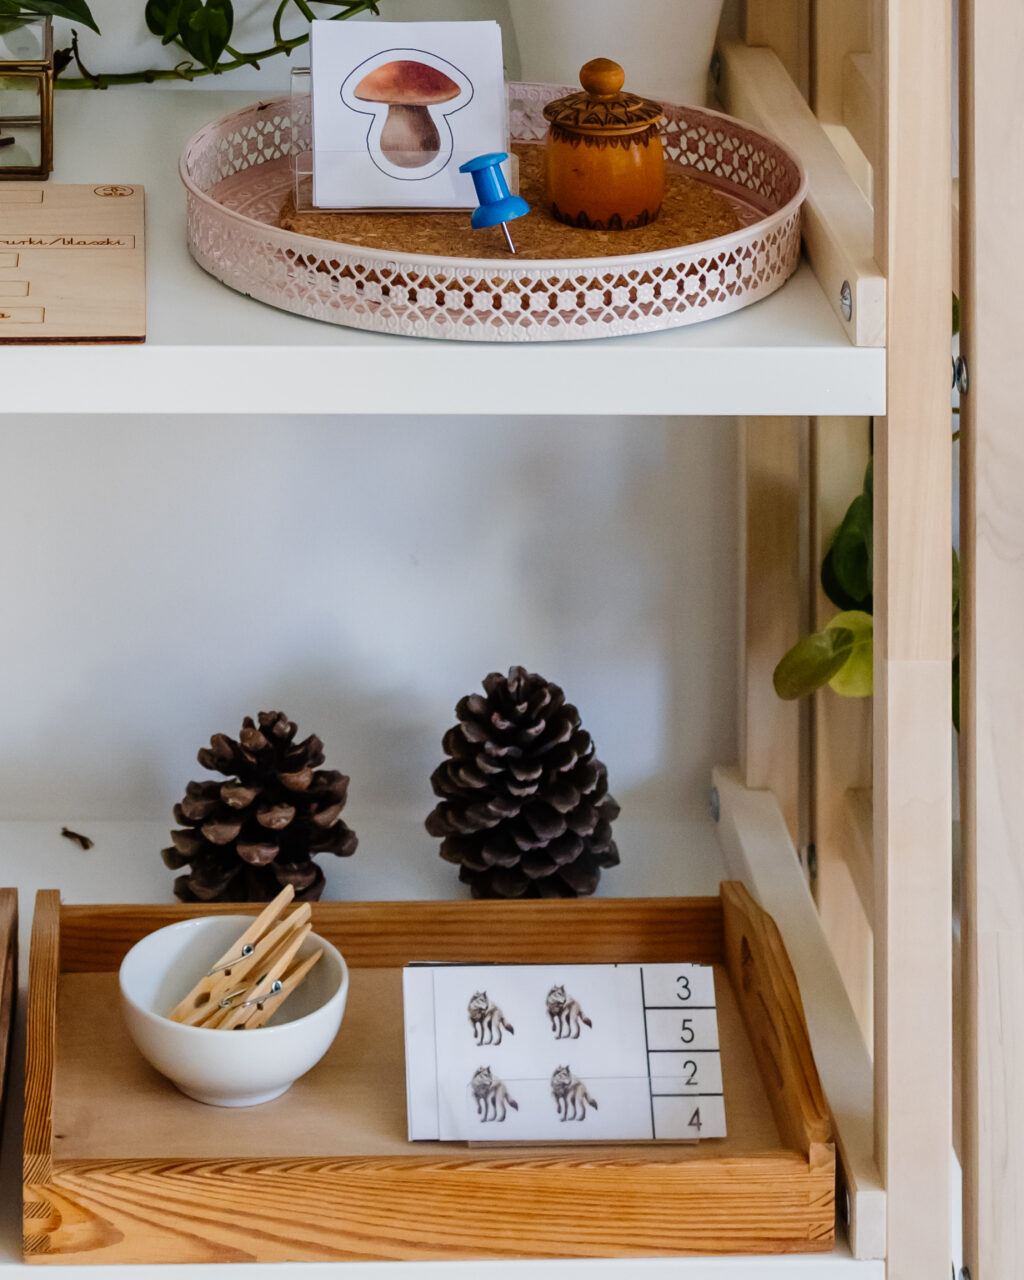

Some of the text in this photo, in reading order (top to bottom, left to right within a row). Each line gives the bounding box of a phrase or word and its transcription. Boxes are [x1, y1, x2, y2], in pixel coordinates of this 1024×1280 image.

[675, 975, 692, 1001] 3
[679, 1018, 695, 1044] 5
[682, 1059, 699, 1086] 2
[687, 1106, 703, 1132] 4
